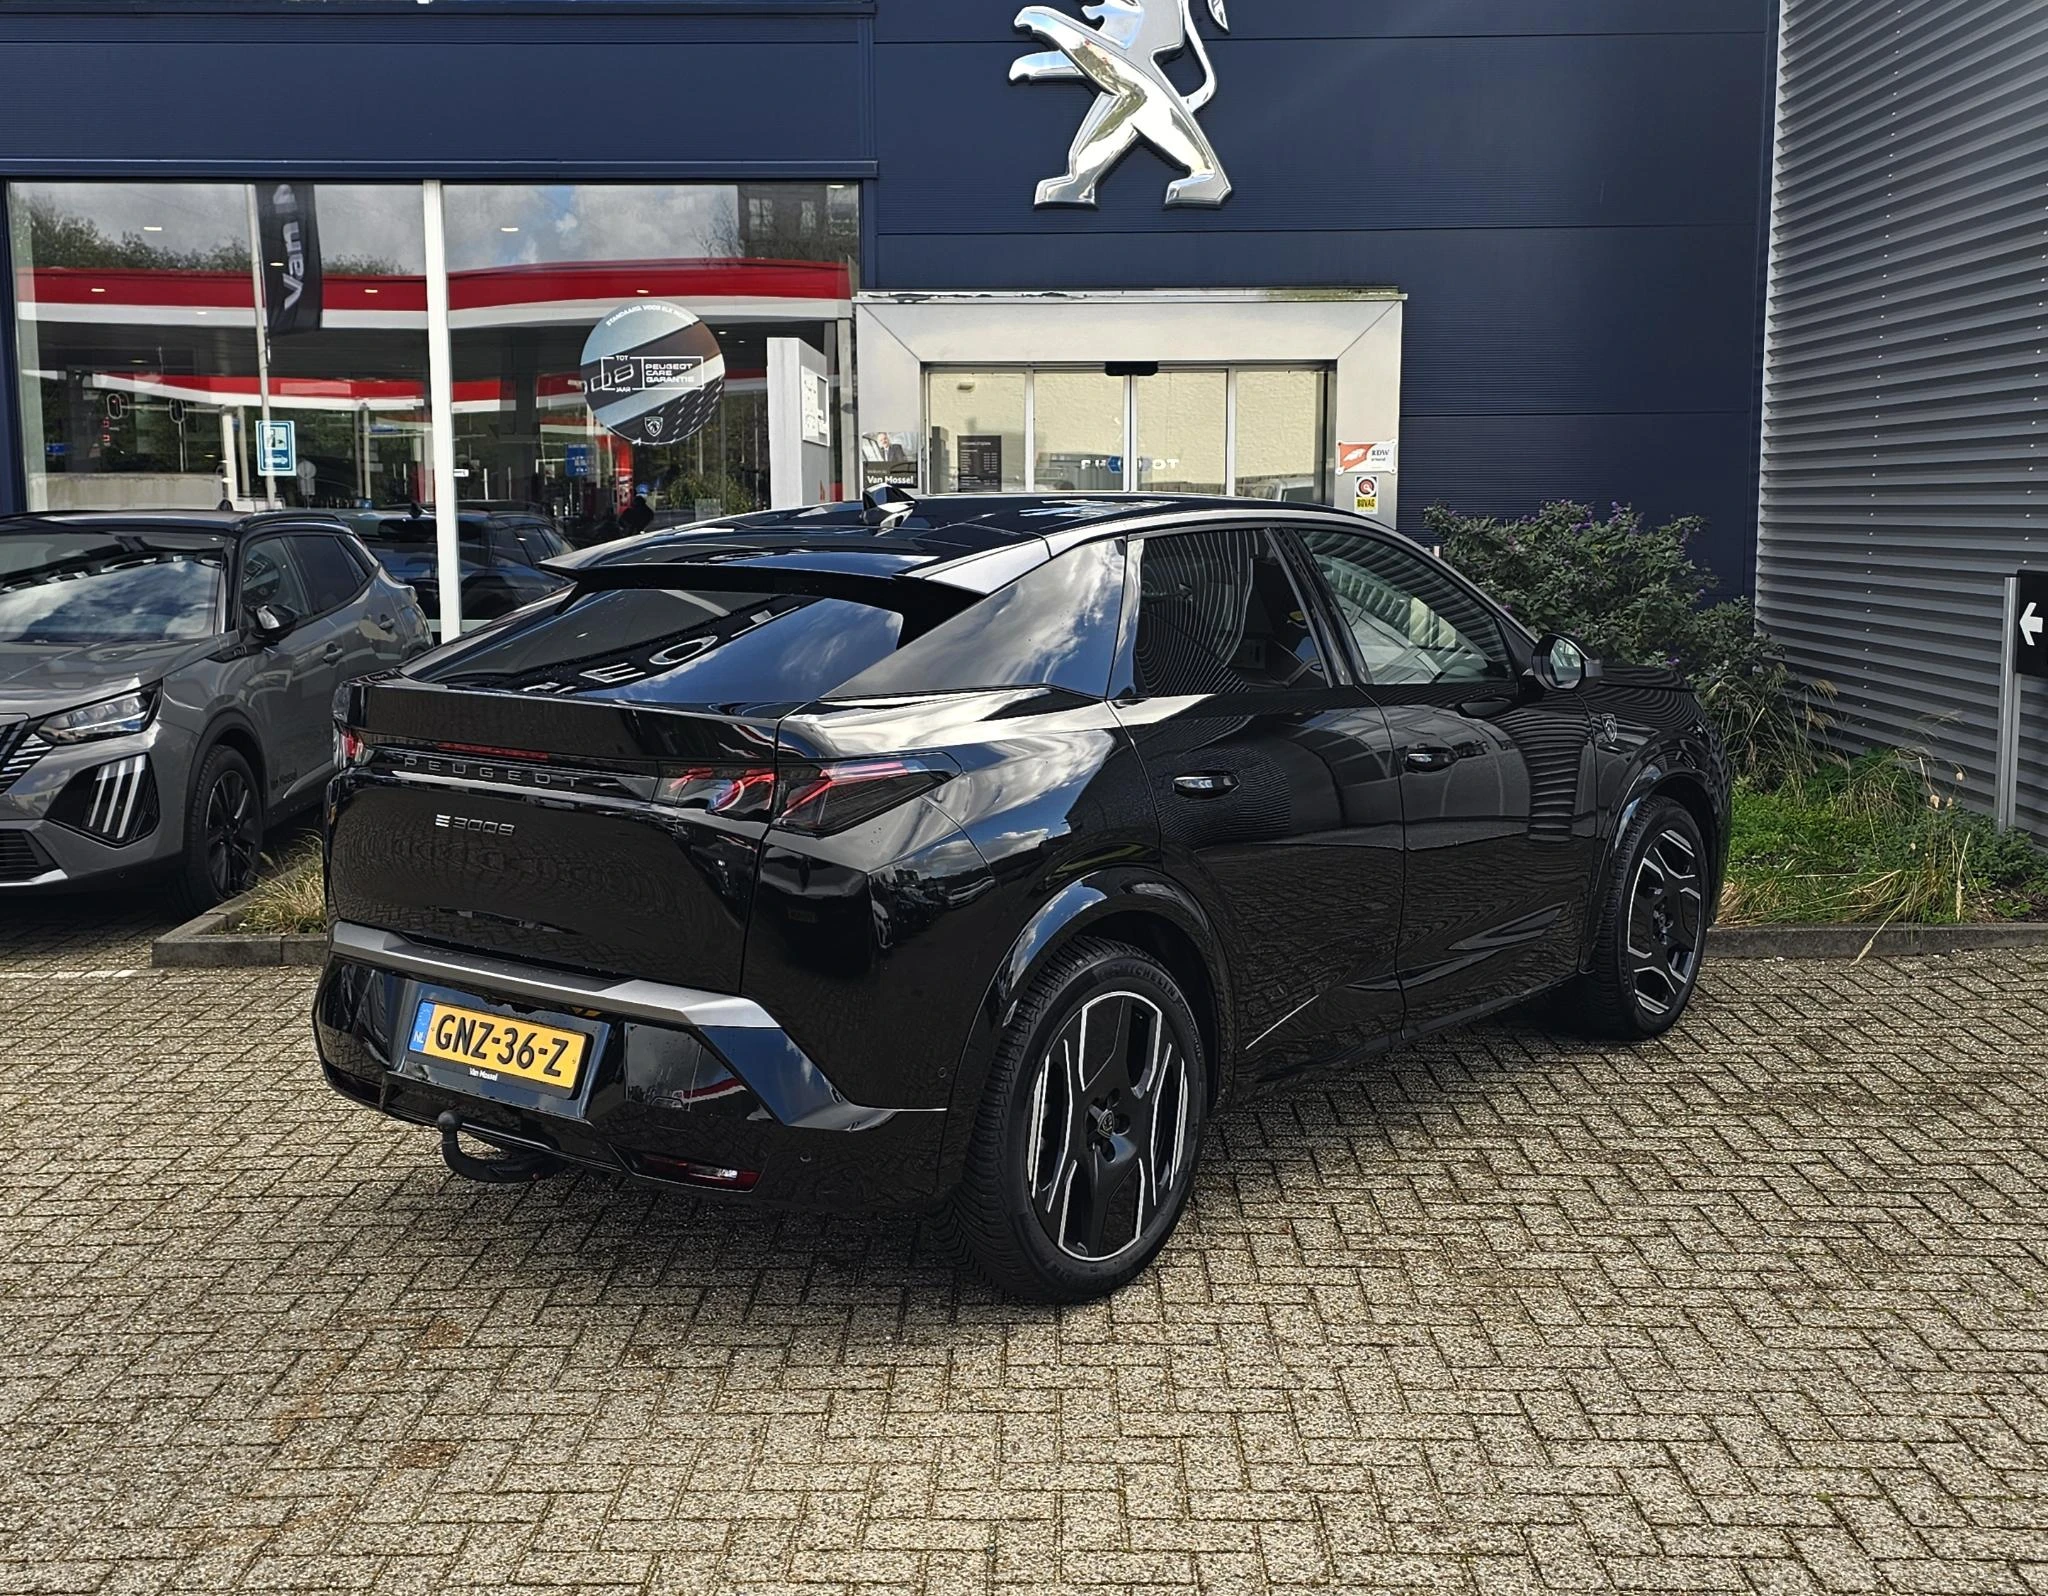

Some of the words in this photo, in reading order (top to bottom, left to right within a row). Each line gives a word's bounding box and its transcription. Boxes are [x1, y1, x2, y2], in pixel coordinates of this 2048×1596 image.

[867, 475, 883, 484] Van
[884, 475, 914, 484] Mossel
[404, 756, 581, 788] PEUGEOT
[413, 1031, 426, 1044] NL
[435, 1013, 569, 1078] GNZ-36-Z
